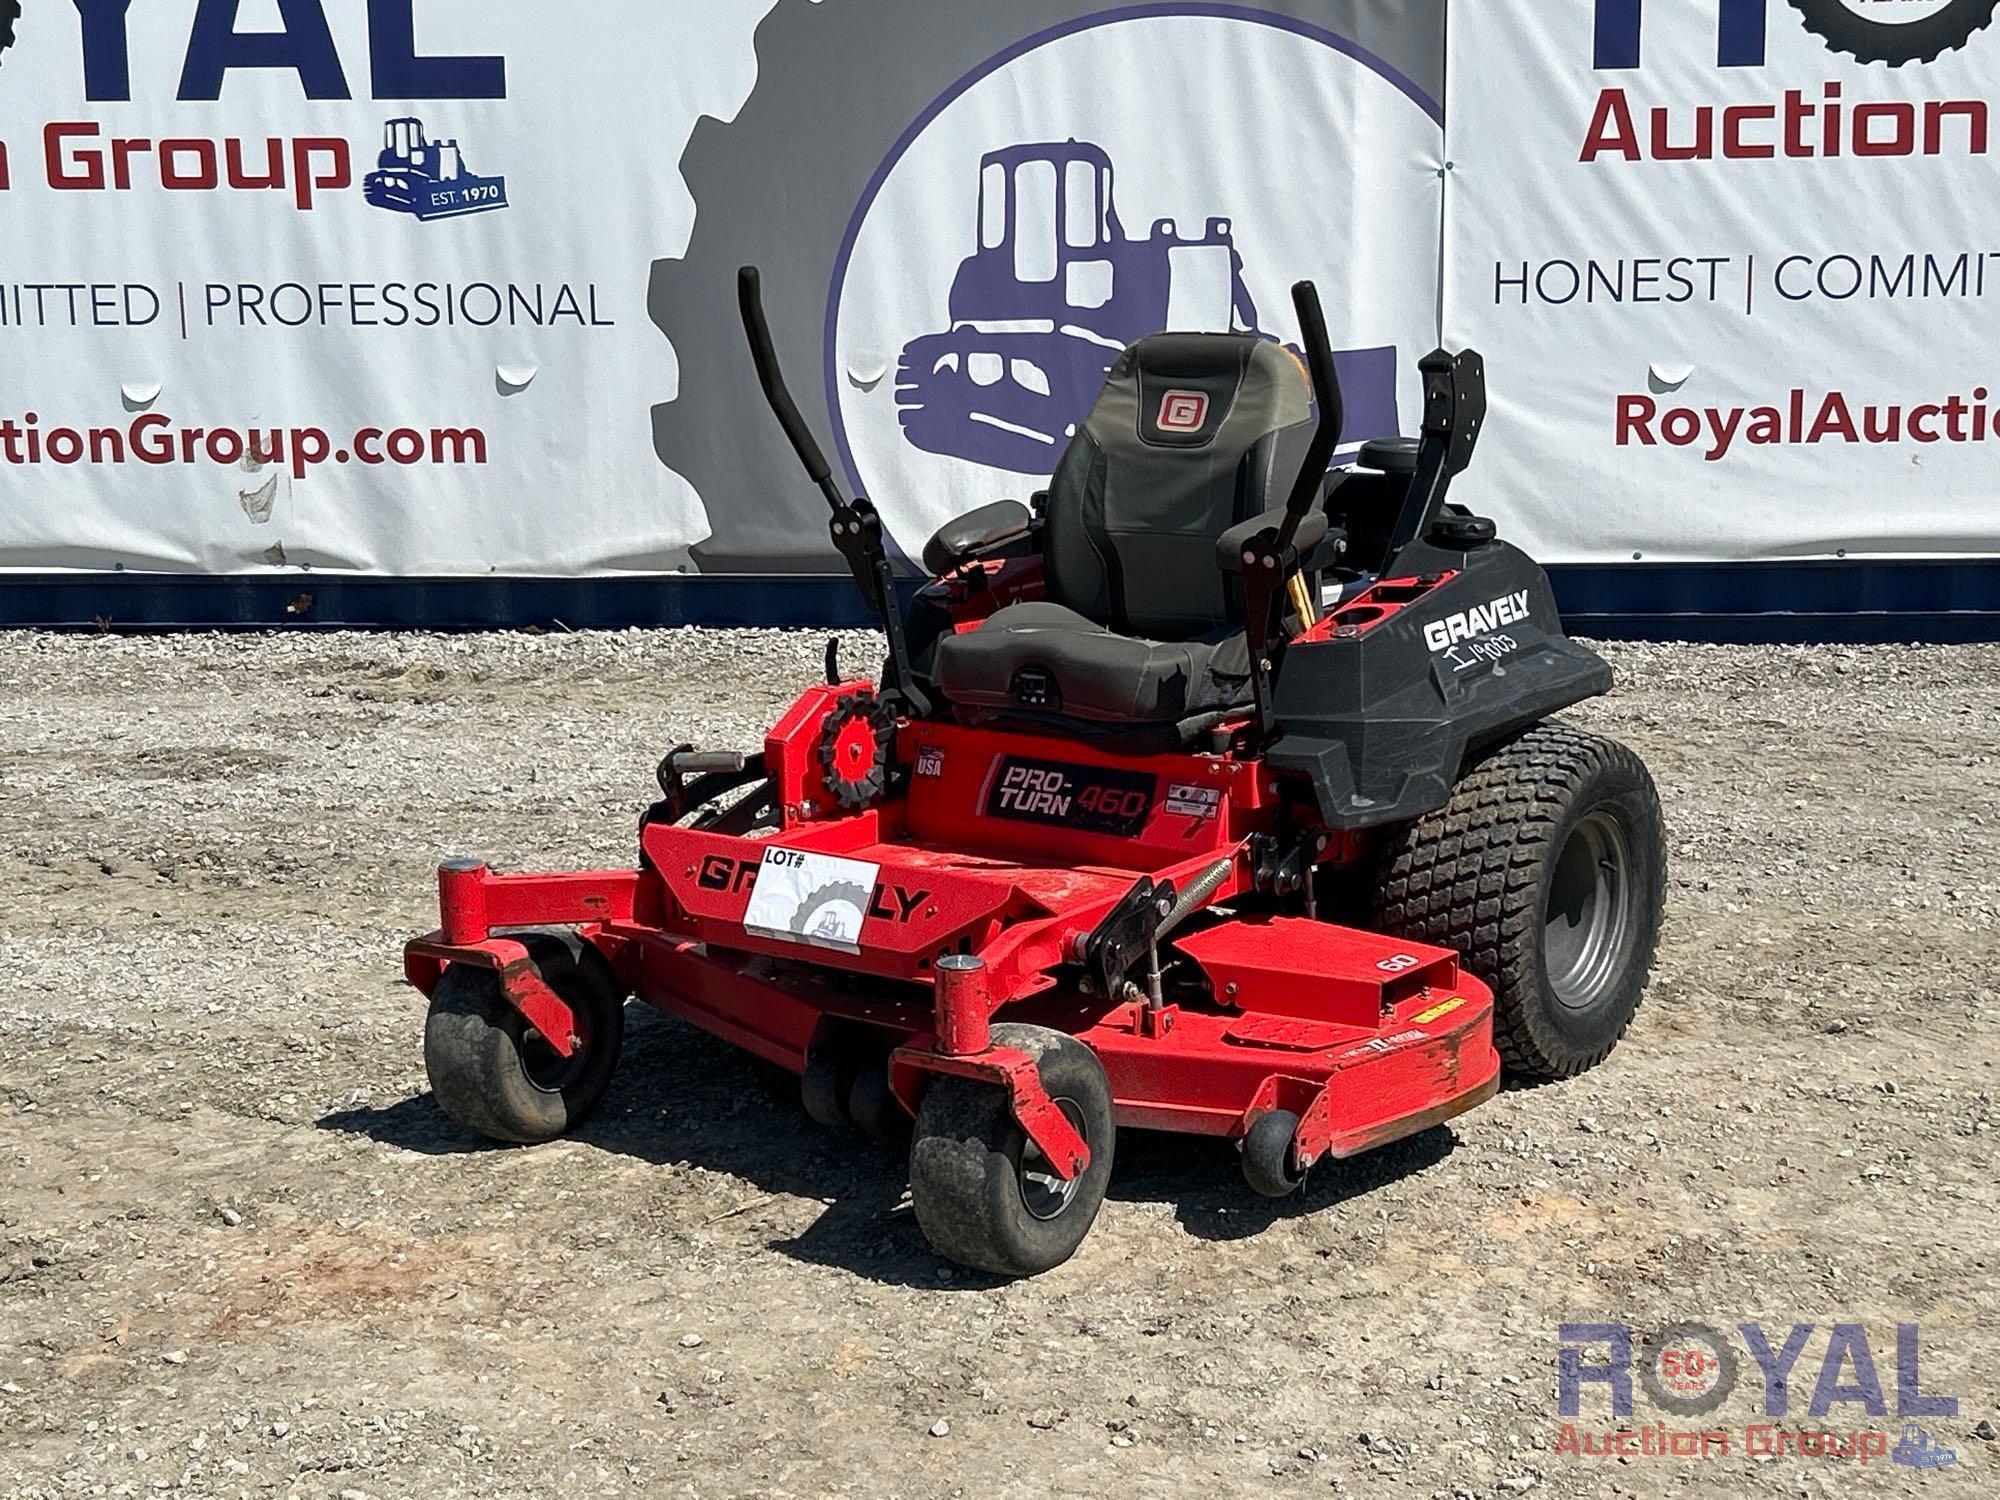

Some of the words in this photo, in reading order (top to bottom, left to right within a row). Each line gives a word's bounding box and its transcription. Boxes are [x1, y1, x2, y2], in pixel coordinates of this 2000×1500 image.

[0, 0, 506, 101] YAL
[1579, 81, 1988, 162] Auction
[43, 121, 351, 210] Group
[431, 191, 459, 206] EST.
[461, 185, 499, 201] 1970
[1494, 257, 1730, 304] HONEST
[0, 284, 160, 326] ITTED
[205, 282, 615, 326] PROFESSIONAL
[1616, 387, 2000, 461] RoyalAucti
[1423, 589, 1530, 652] GRAVELY
[917, 758, 941, 776] USA
[1003, 766, 1072, 793] PRO-
[1000, 787, 1071, 817] TURN
[1078, 785, 1147, 817] 460
[763, 848, 805, 869] LOT#
[697, 854, 930, 923] GRLY
[1376, 954, 1420, 972] 60
